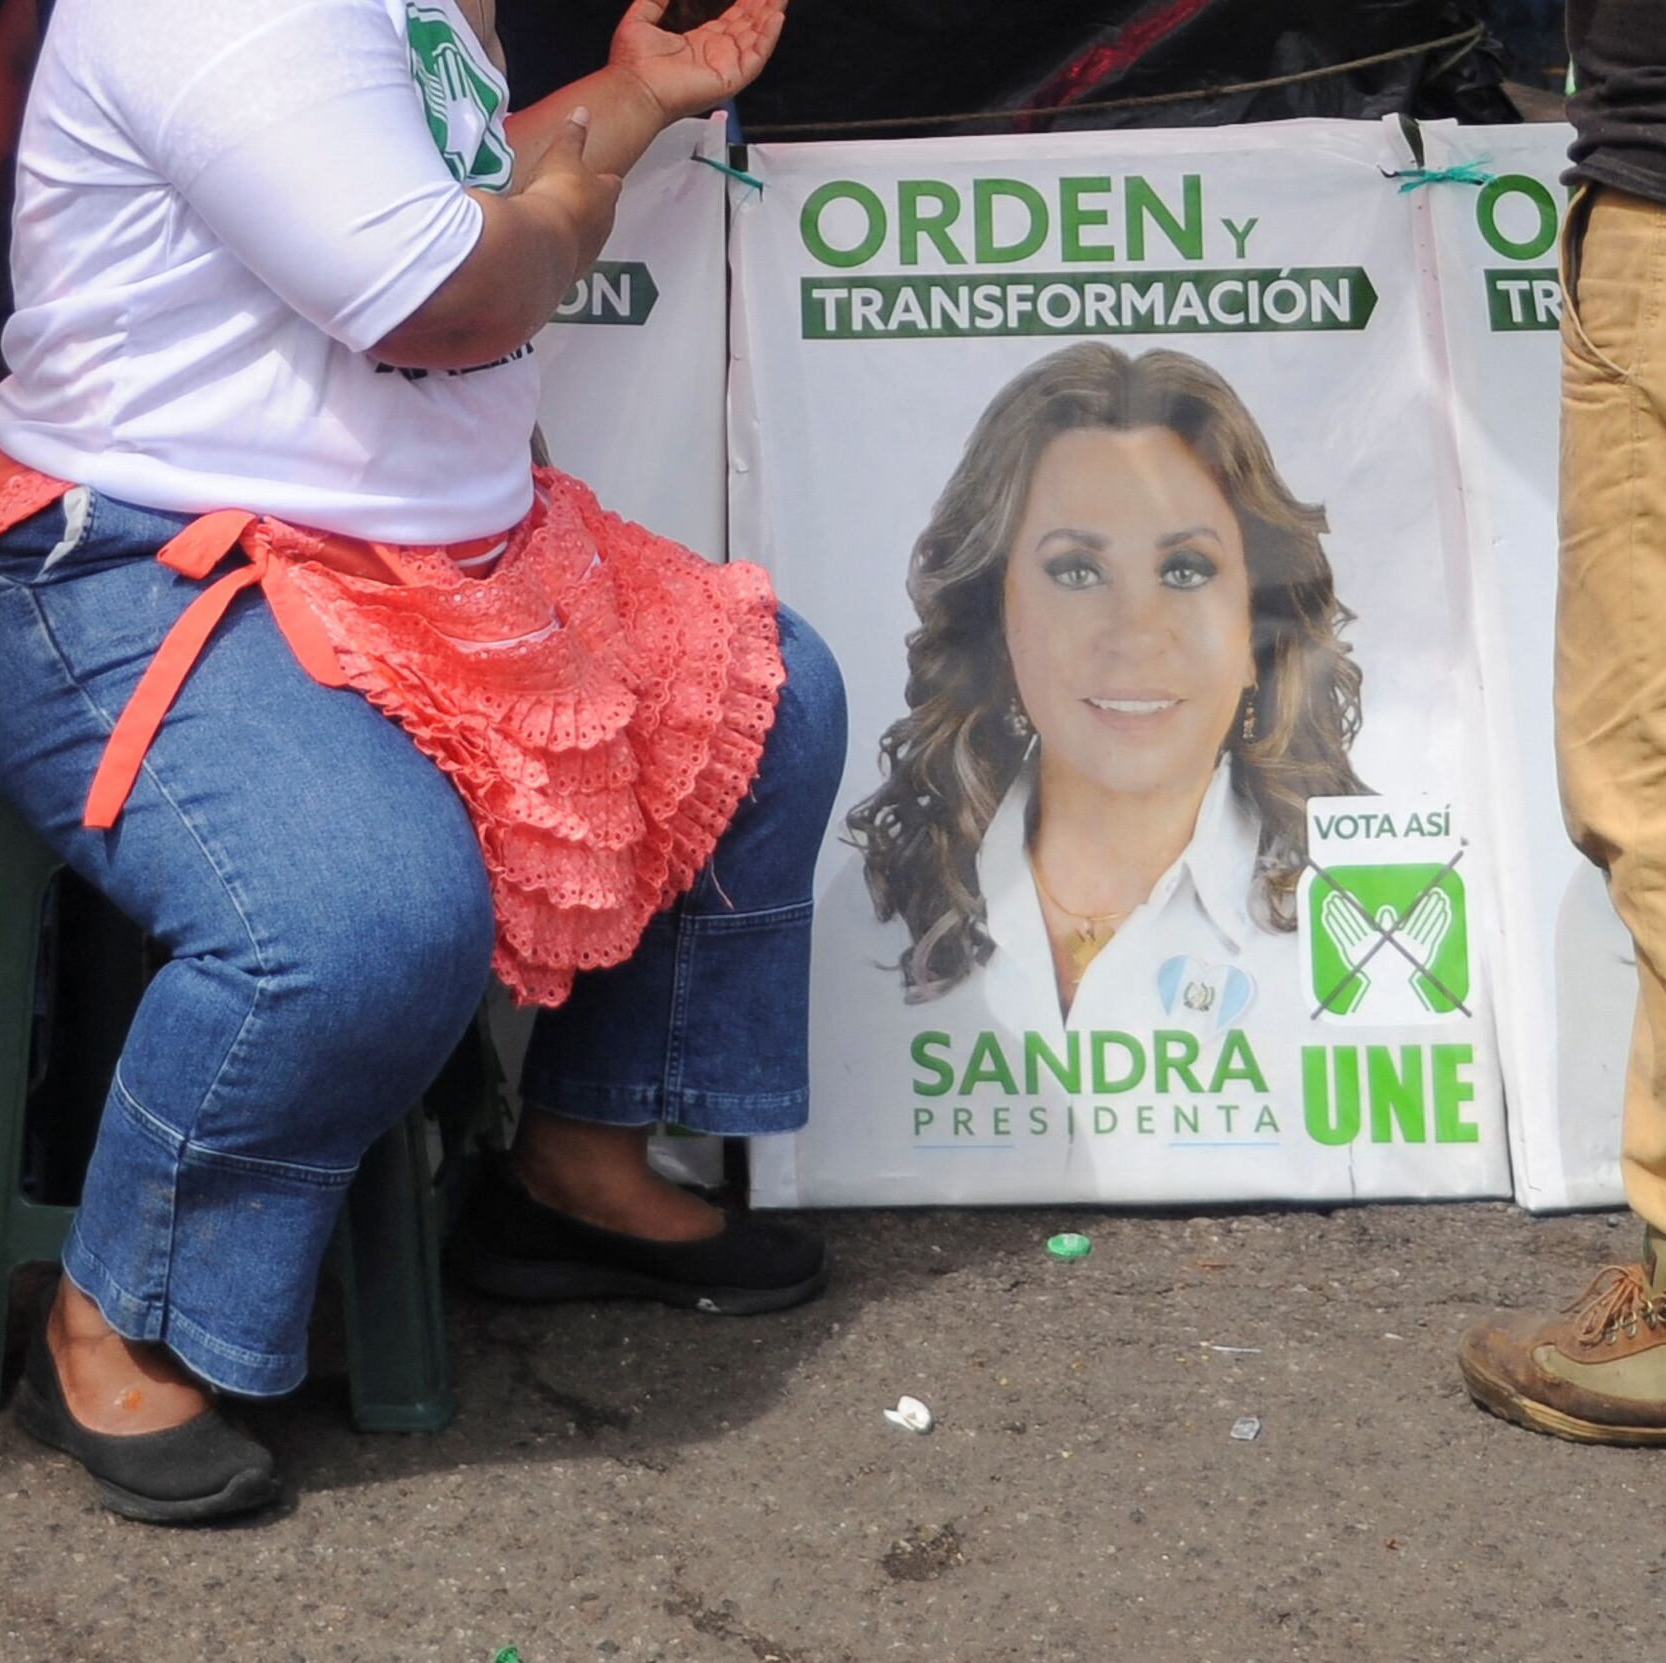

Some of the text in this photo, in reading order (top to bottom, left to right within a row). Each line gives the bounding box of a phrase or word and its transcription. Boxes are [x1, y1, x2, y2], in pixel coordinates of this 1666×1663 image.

[799, 174, 1260, 268] ORDEN Y
[812, 267, 1353, 334] TRANSFORMACIÓN
[1313, 804, 1454, 842] VOTA ASÍ
[909, 1027, 1270, 1096] SANDRA
[913, 1044, 1480, 1146] PRESIDENTA UNE
